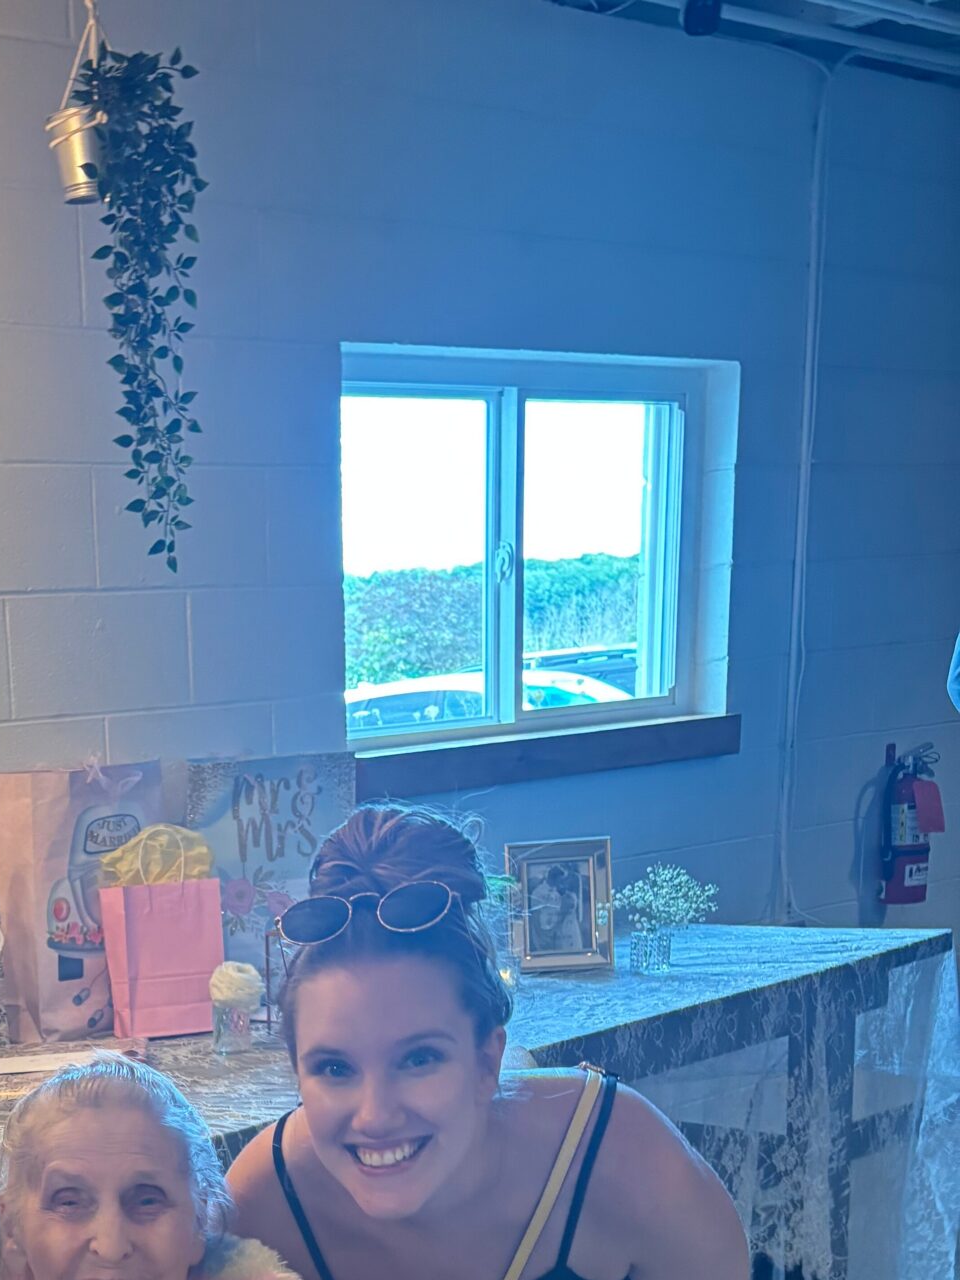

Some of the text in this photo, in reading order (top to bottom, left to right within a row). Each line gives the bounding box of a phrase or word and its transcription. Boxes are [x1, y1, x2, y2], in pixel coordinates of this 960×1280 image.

[232, 772, 291, 820] Mr
[96, 817, 128, 832] JUST
[235, 816, 318, 863] Mrs
